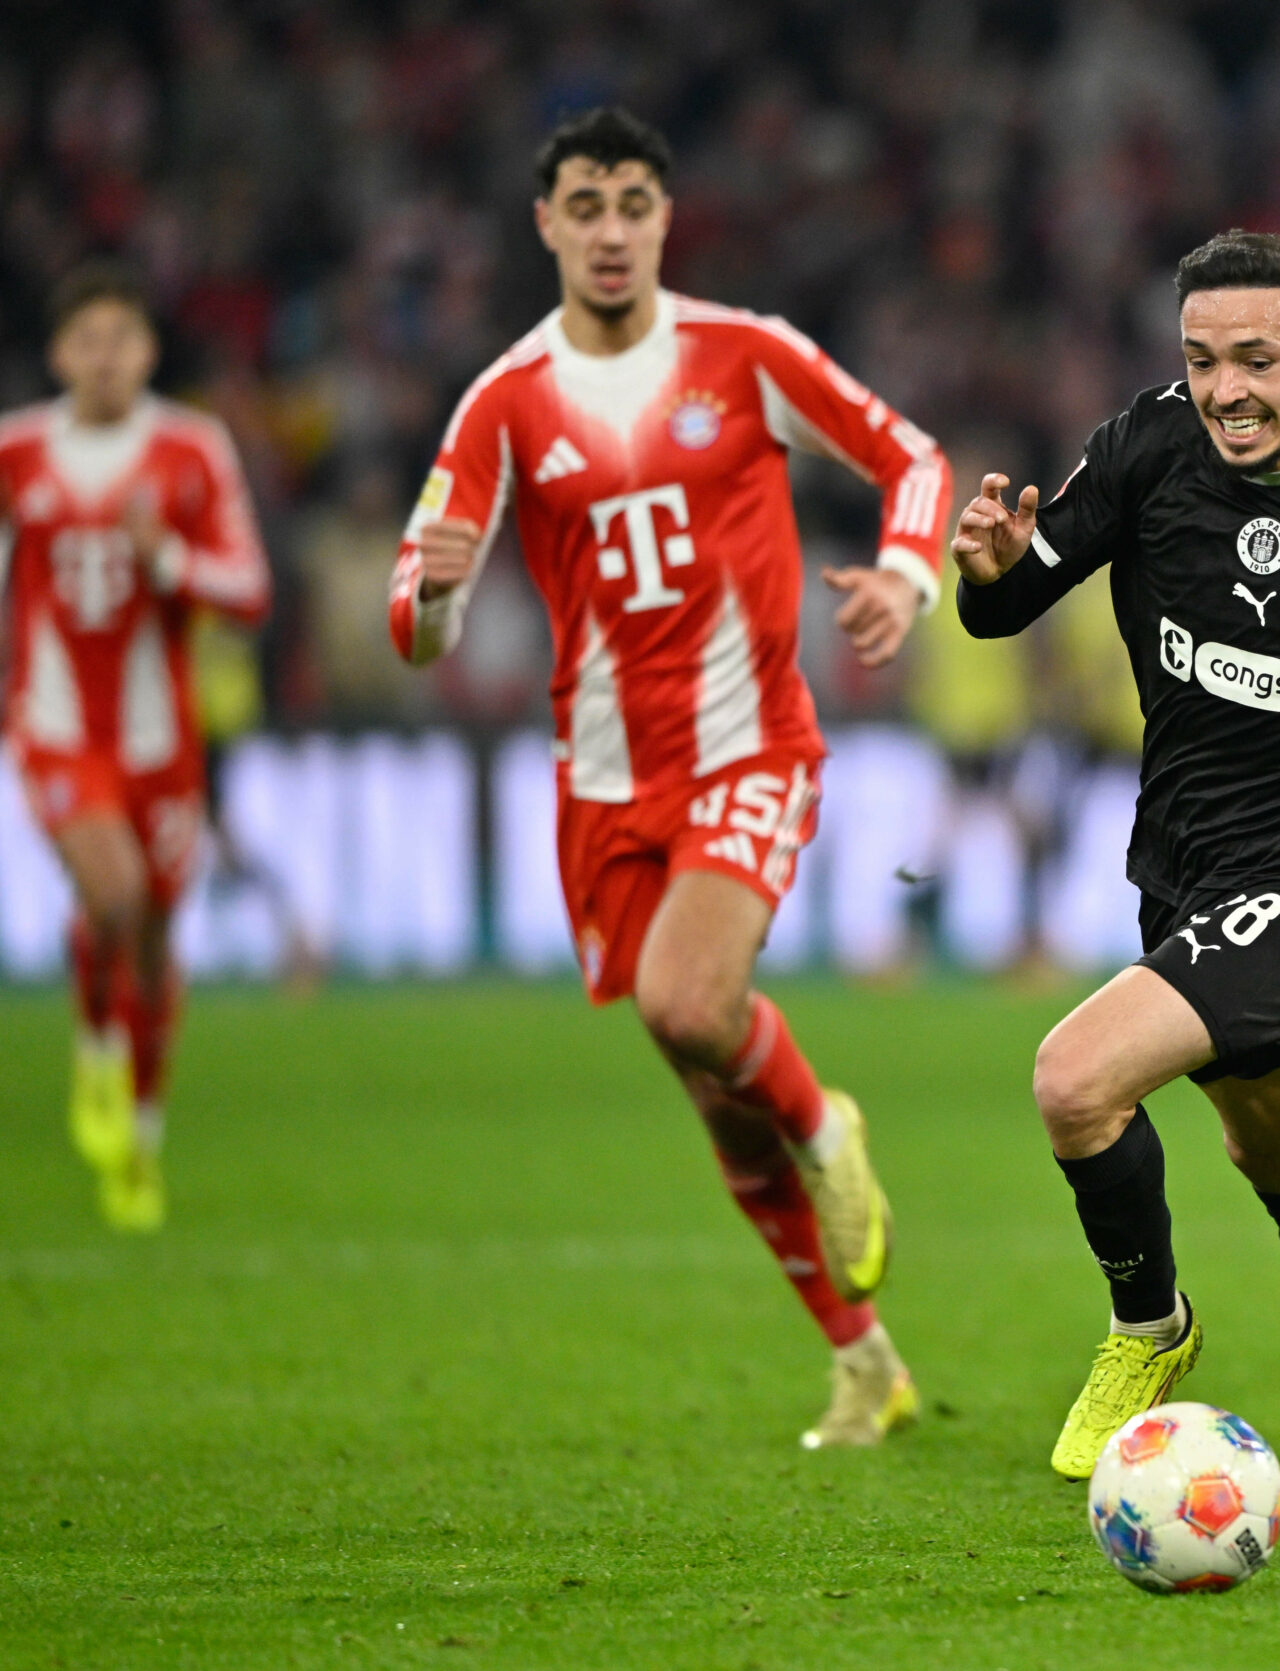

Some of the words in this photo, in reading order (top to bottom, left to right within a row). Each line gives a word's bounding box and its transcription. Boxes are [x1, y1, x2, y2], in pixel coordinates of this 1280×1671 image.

[1240, 529, 1250, 541] FC
[1251, 520, 1264, 530] ST.
[589, 482, 696, 614] T
[1250, 561, 1270, 573] 1910
